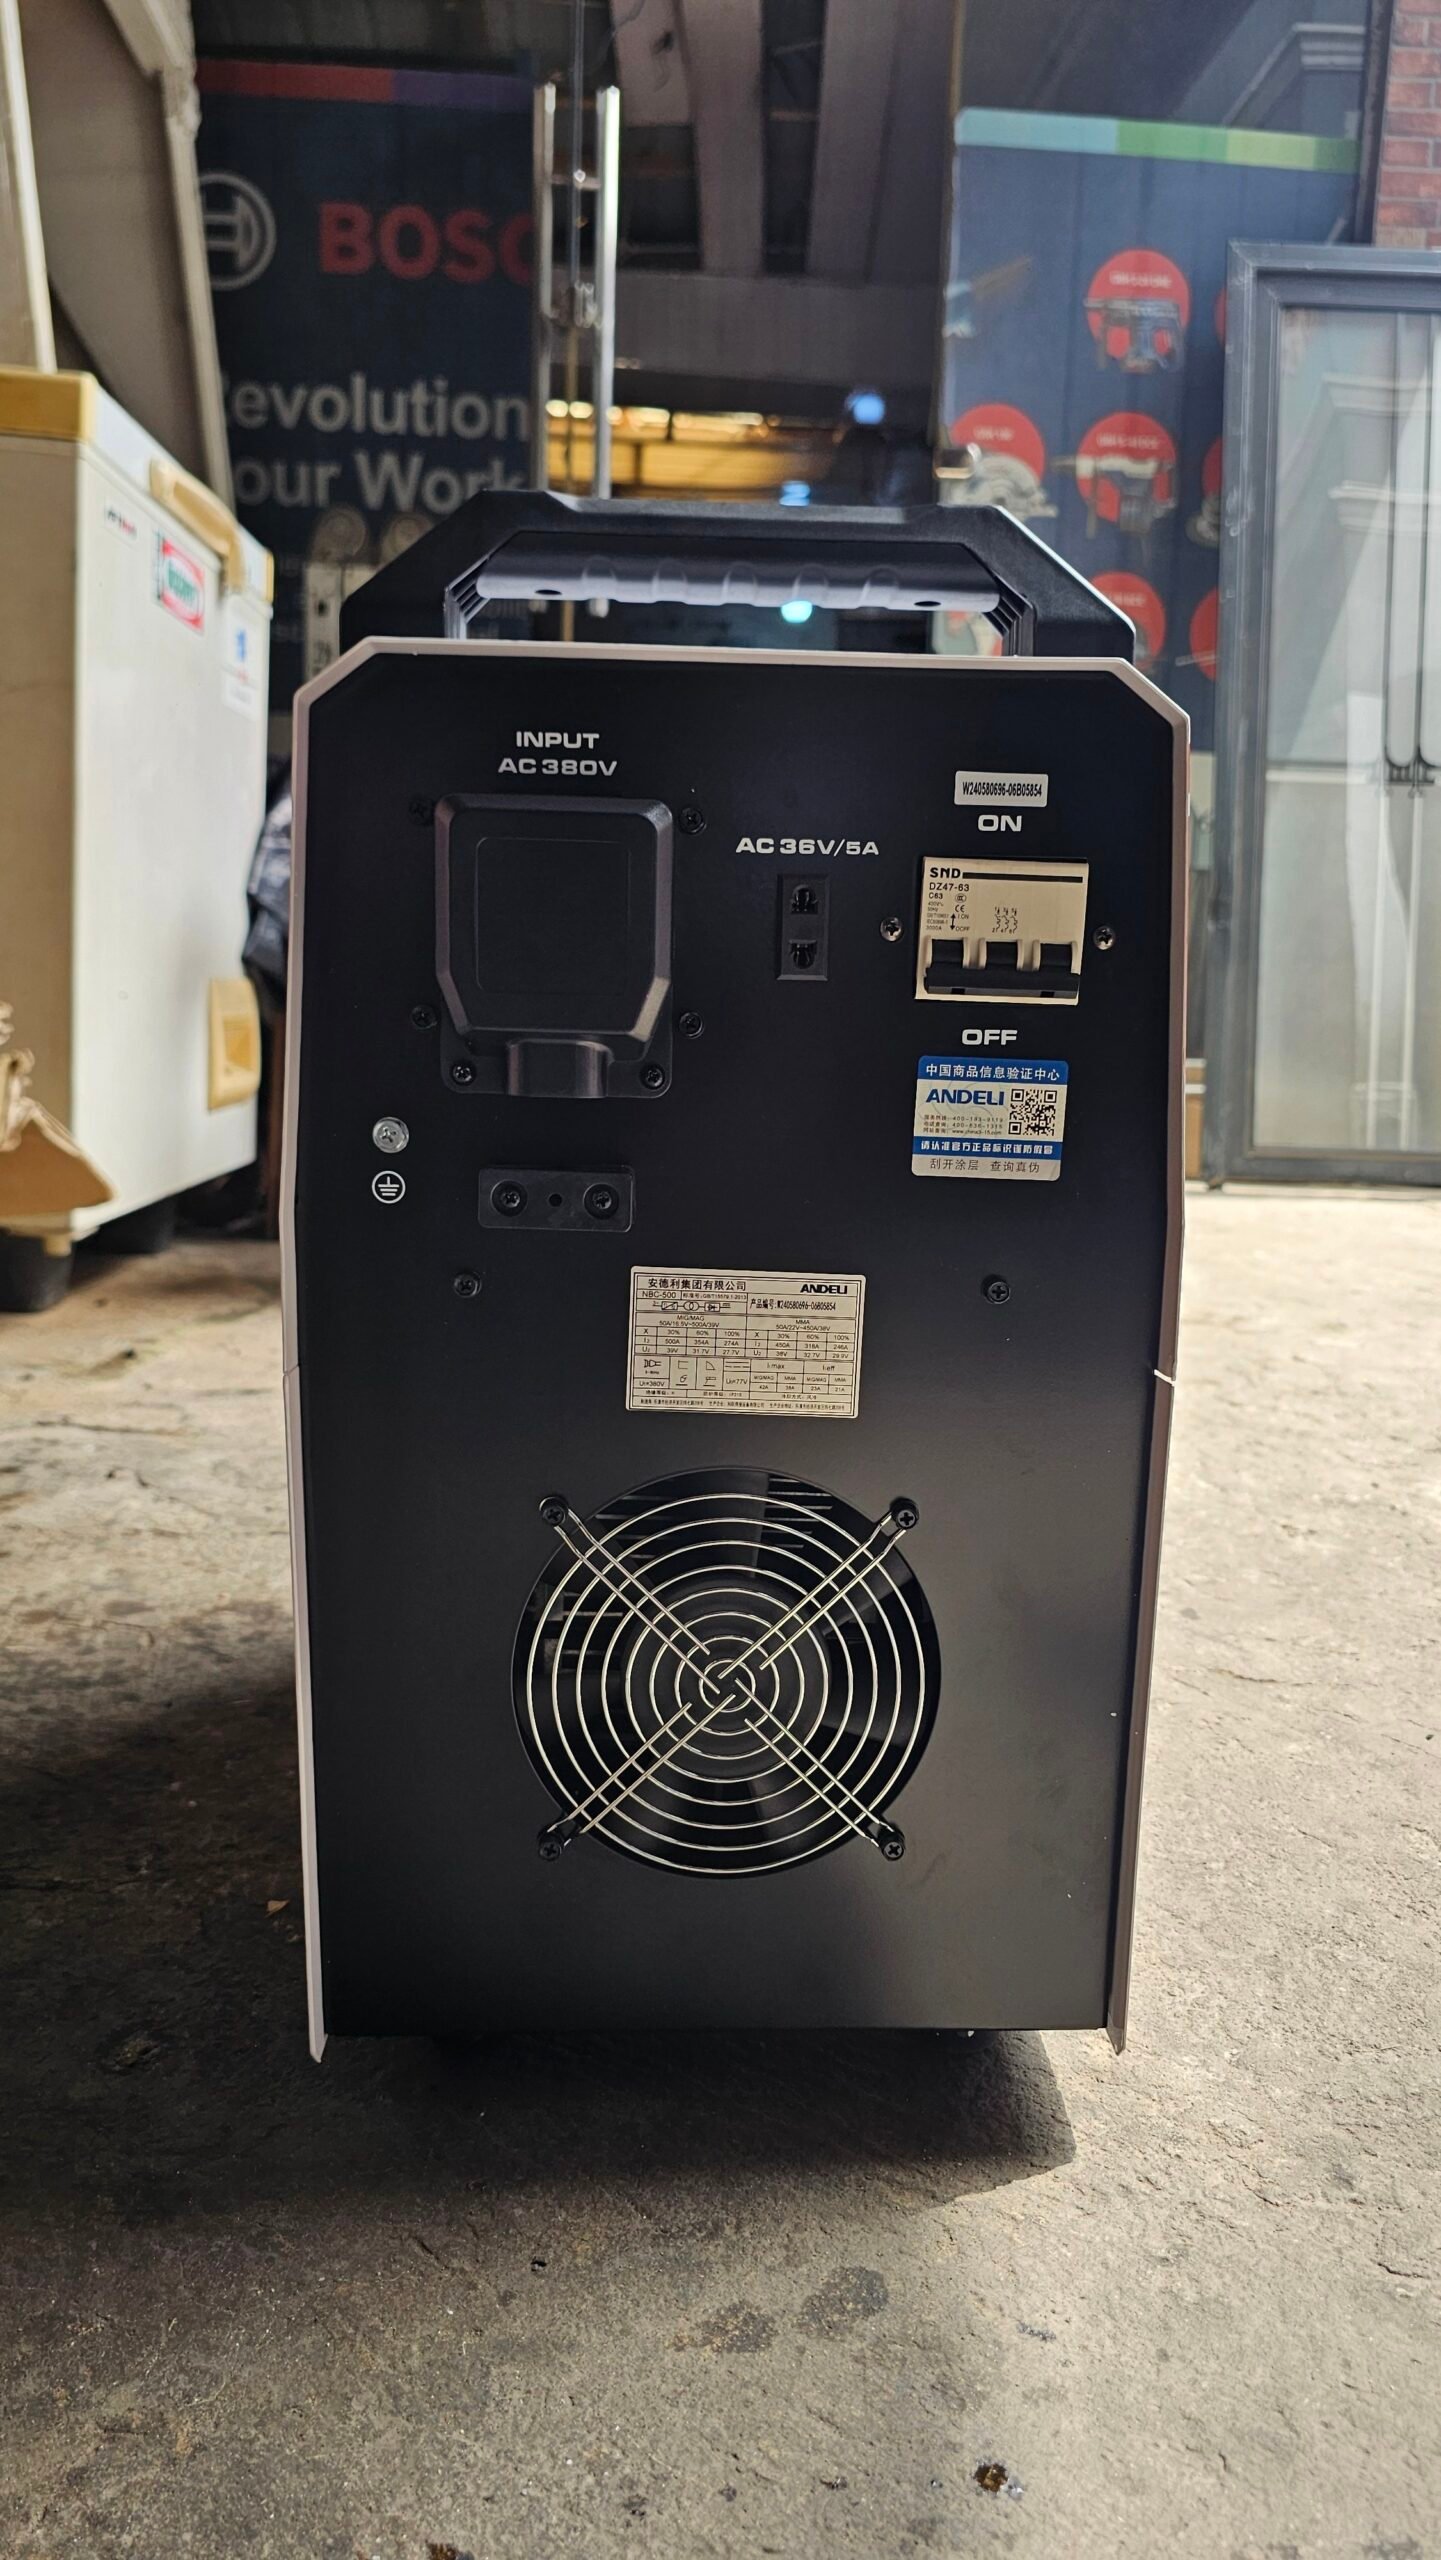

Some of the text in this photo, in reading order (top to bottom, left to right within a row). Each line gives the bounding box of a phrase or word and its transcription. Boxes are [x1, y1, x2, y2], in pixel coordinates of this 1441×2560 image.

[224, 371, 529, 441] evolution
[516, 731, 600, 749] INPUT
[963, 782, 1042, 797] W240580696-06B05854
[978, 814, 1022, 832] ON
[930, 867, 961, 879] SND
[929, 882, 970, 892] DZ47-63
[928, 892, 943, 900] C63
[962, 1029, 1018, 1045] OFF
[926, 1064, 1060, 1081] 中国商品信息验证中心
[926, 1089, 1005, 1106] ANDELI
[930, 1159, 1041, 1173] 刮开涂层 查询真伪
[648, 1279, 746, 1291] 安德利集团有限公司
[800, 1284, 848, 1294] ANDELI
[642, 1290, 677, 1299] NBC-500
